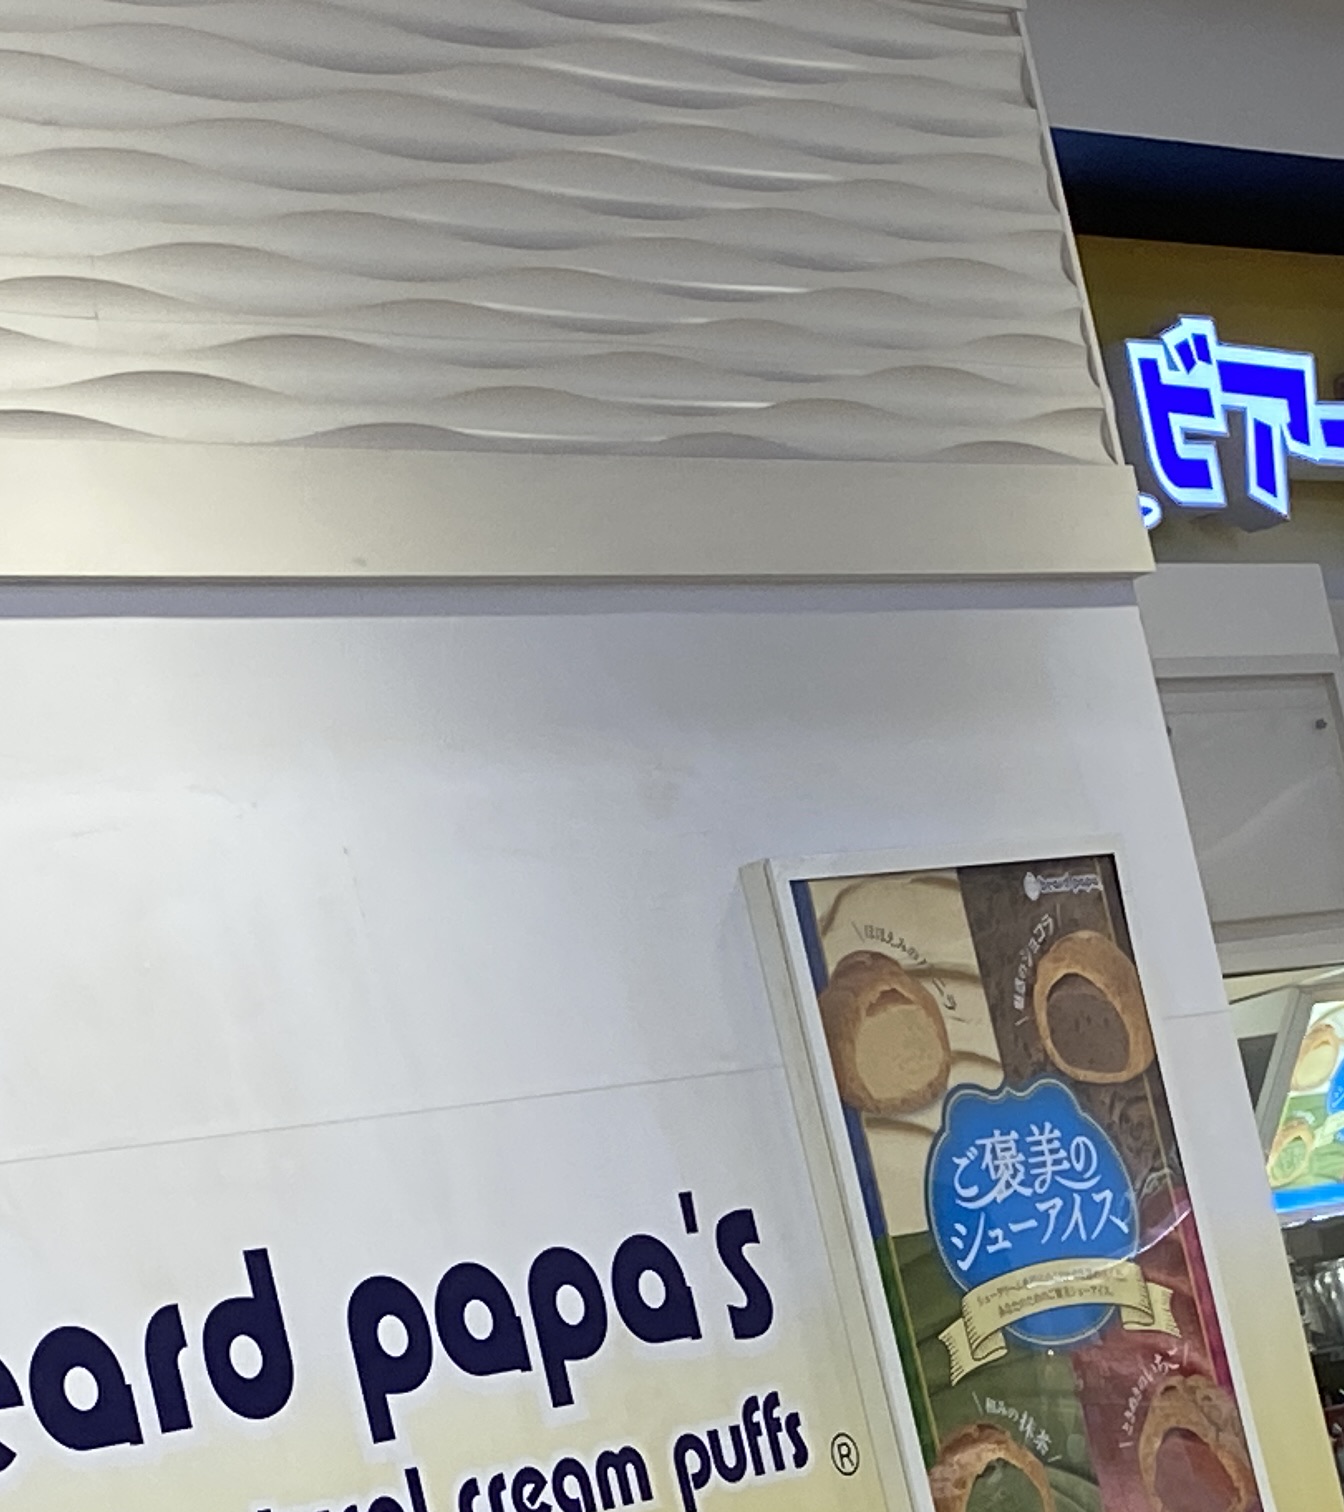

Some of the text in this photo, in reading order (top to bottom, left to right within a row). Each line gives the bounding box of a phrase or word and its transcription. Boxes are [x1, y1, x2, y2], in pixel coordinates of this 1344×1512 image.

[951, 1120, 1103, 1210] ご褒美の
[950, 1188, 1130, 1272] シューアイス
[348, 1192, 773, 1444] papa's
